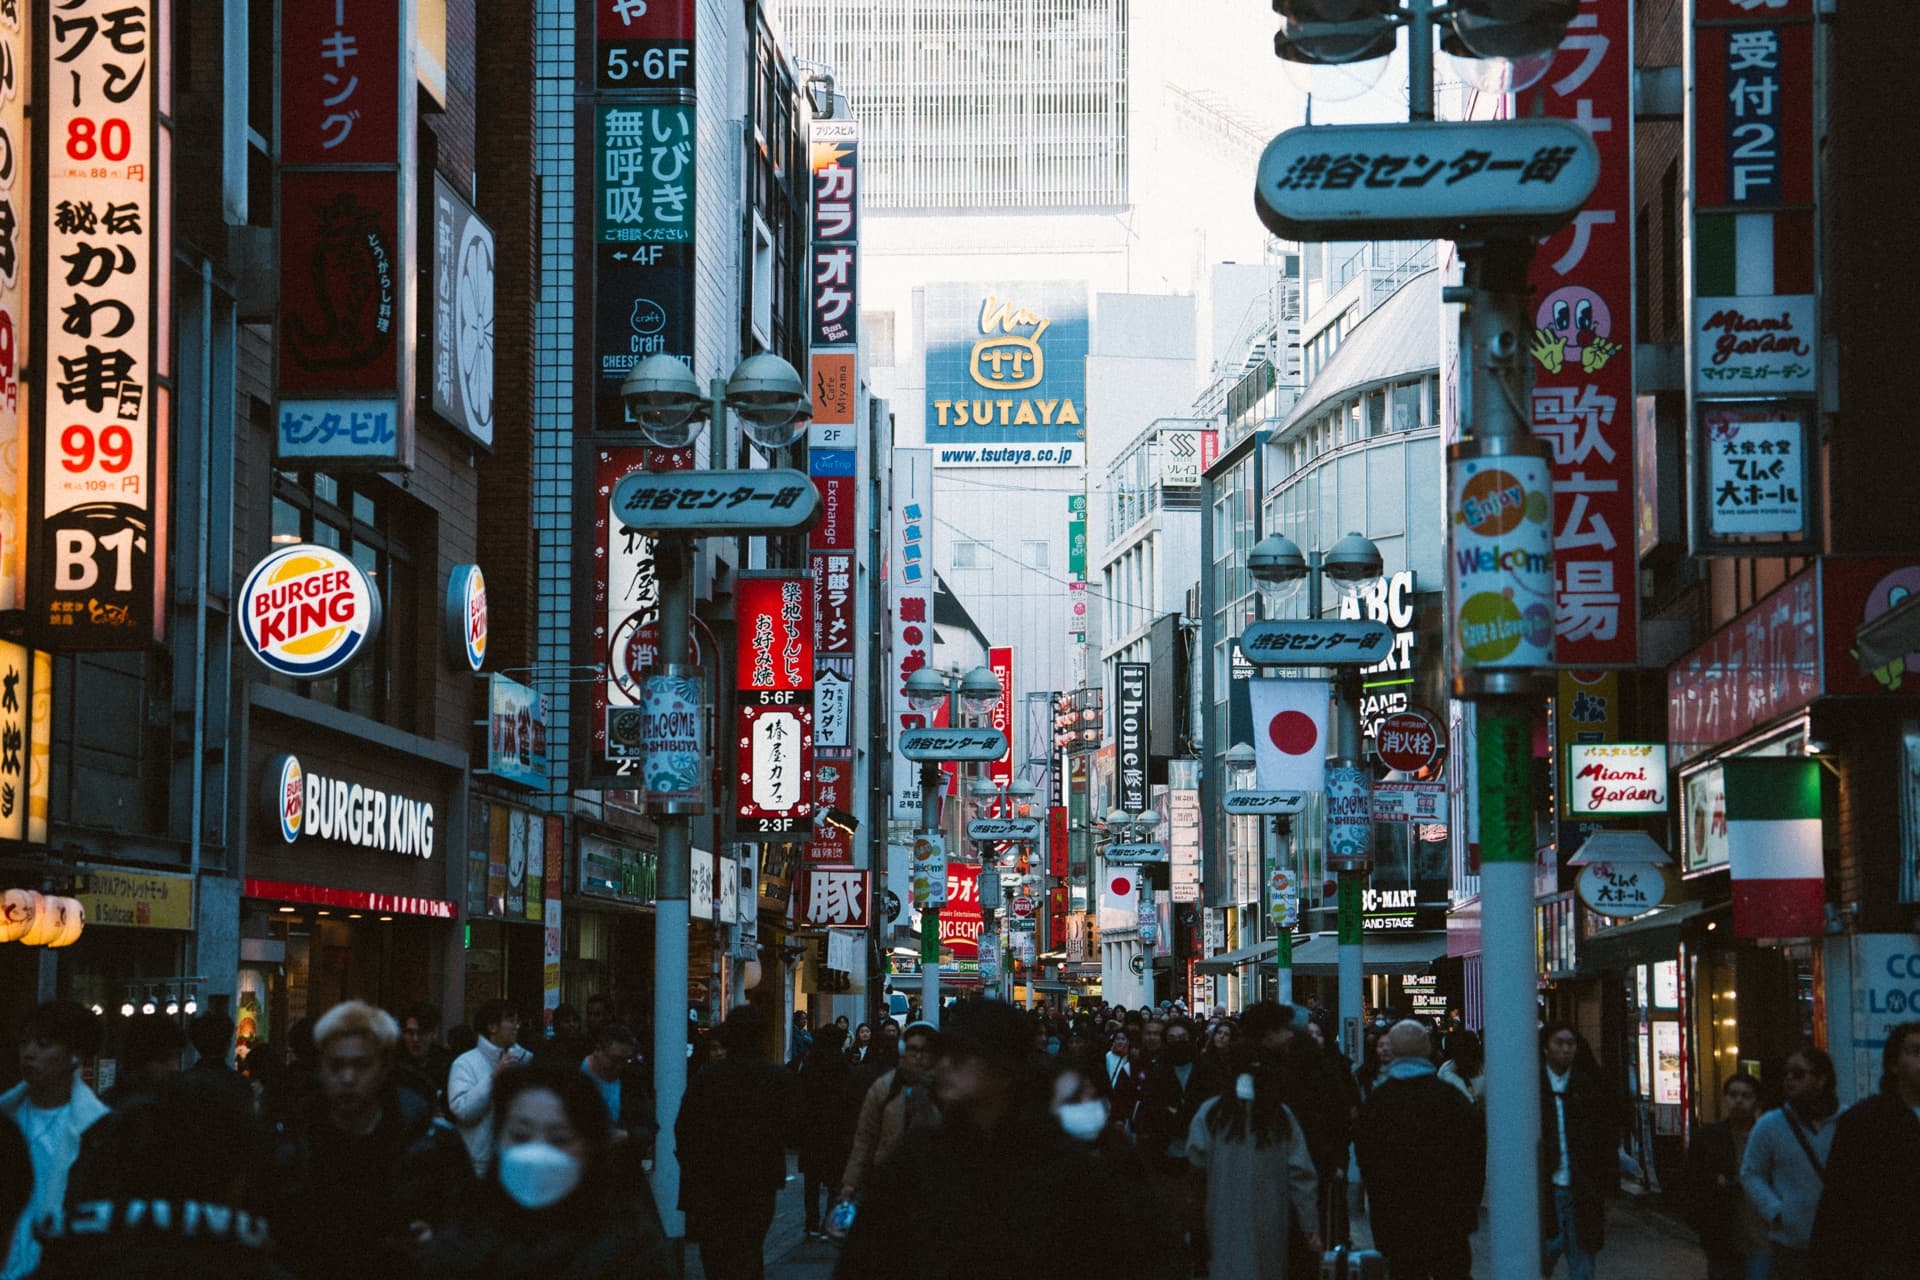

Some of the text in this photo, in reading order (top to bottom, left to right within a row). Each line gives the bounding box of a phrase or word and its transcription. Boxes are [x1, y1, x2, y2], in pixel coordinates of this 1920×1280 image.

[1728, 29, 1780, 201] 受付2F
[65, 116, 132, 162] 80
[604, 108, 645, 225] 無呼吸
[651, 108, 692, 222] いびき
[1277, 145, 1579, 191] 渋谷センター街
[54, 200, 143, 236] 秘伝
[604, 228, 689, 241] ご相談ください
[631, 245, 664, 266] 4F
[816, 162, 852, 324] カラオケ
[1701, 309, 1793, 334] Miami
[630, 334, 666, 353] Craft
[1701, 363, 1811, 381] マイアミガーデン
[281, 411, 395, 446] センタービル
[933, 399, 1081, 426] TSUTAYA
[60, 424, 133, 474] 99
[823, 429, 841, 441] 2F
[941, 446, 1073, 464] www.tsutaya.co.jp
[1727, 458, 1785, 482] てんぐ
[624, 486, 805, 511] 渋谷センター街
[1462, 485, 1523, 526] Enjoy
[1715, 480, 1799, 506] 大ホール
[824, 480, 839, 545] Exchange
[55, 527, 135, 592] B1
[255, 569, 351, 618] BURGER
[827, 555, 850, 651] 野郎ラーメン
[258, 592, 355, 651] KING
[782, 582, 802, 686] 築地もんじゃ
[752, 614, 775, 687] お好み焼
[1250, 632, 1384, 651] 渋谷センター街
[905, 736, 999, 751] 渋谷センター街
[1382, 730, 1432, 757] 消火栓
[1576, 763, 1648, 782] Miami
[304, 772, 434, 860] BURGER KING
[1598, 886, 1646, 902] 大ホール
[1607, 870, 1639, 888] てんぐ
[806, 871, 863, 924] 豚
